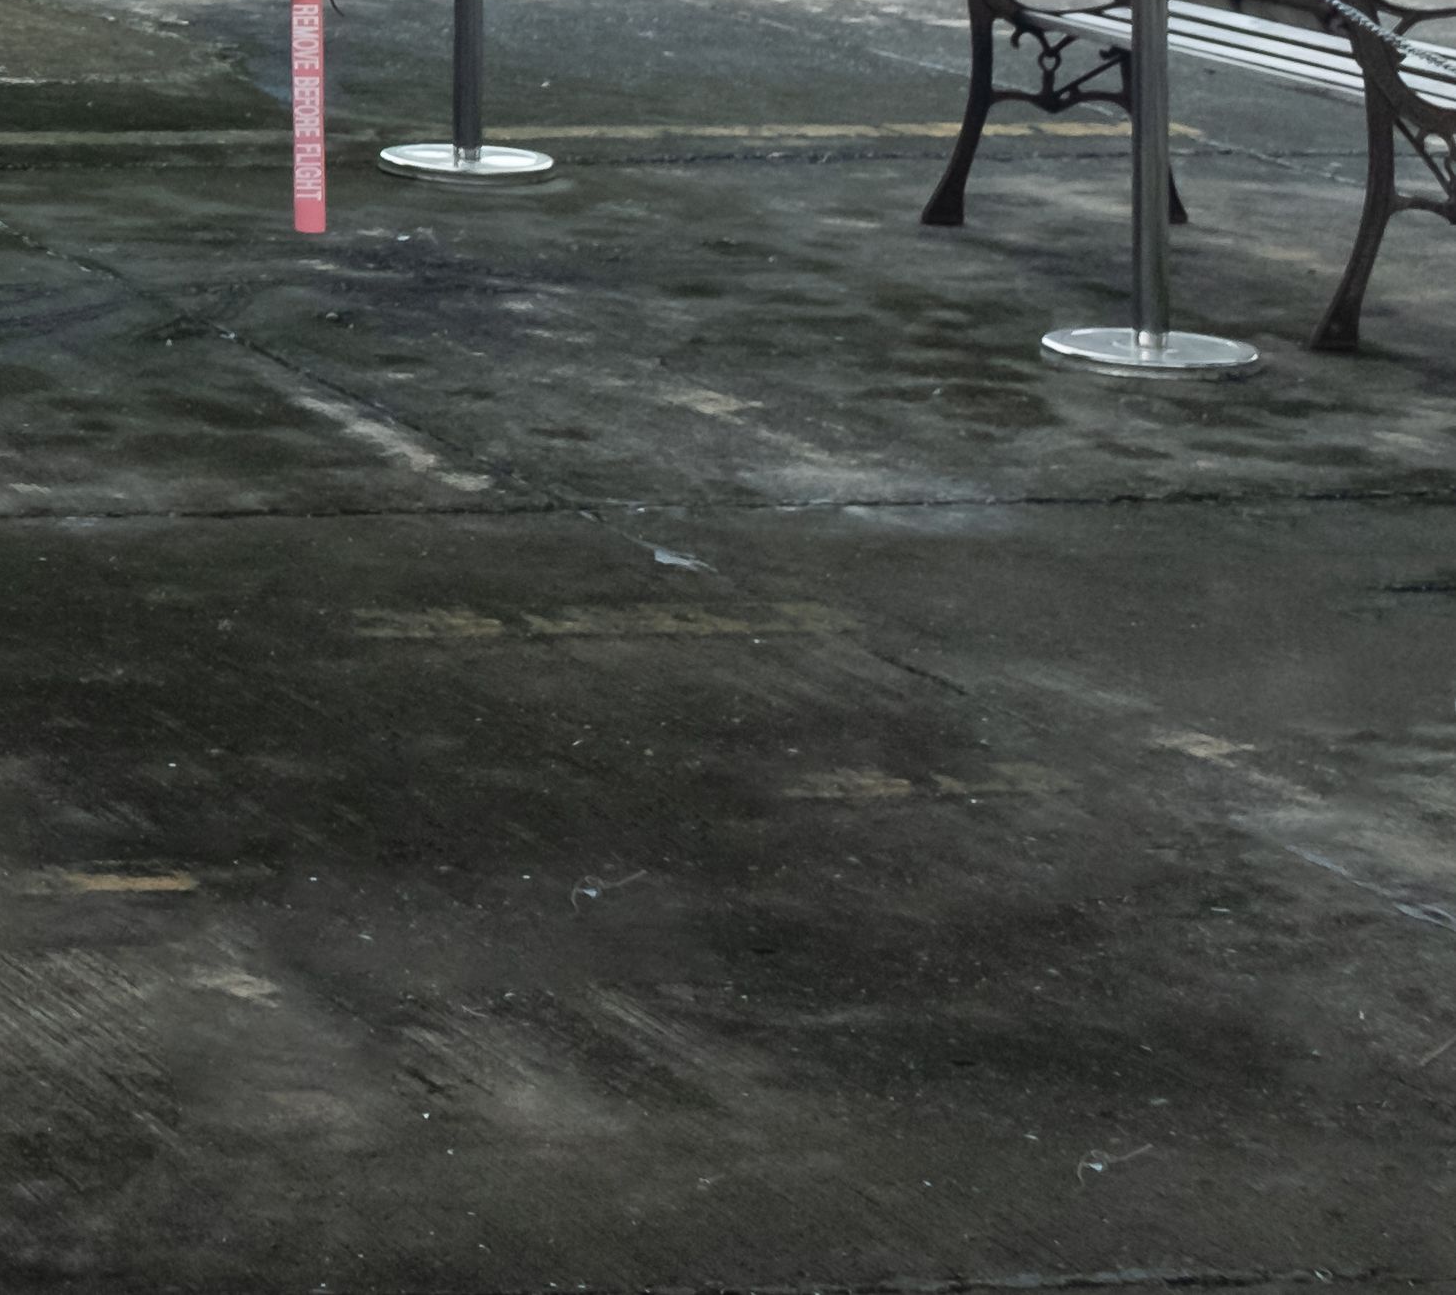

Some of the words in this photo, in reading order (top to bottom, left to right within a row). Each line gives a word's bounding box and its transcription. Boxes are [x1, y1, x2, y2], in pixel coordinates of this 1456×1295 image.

[292, 4, 319, 70] REMOVE
[293, 76, 320, 138] BEFORE
[294, 143, 322, 202] FLIGHT
